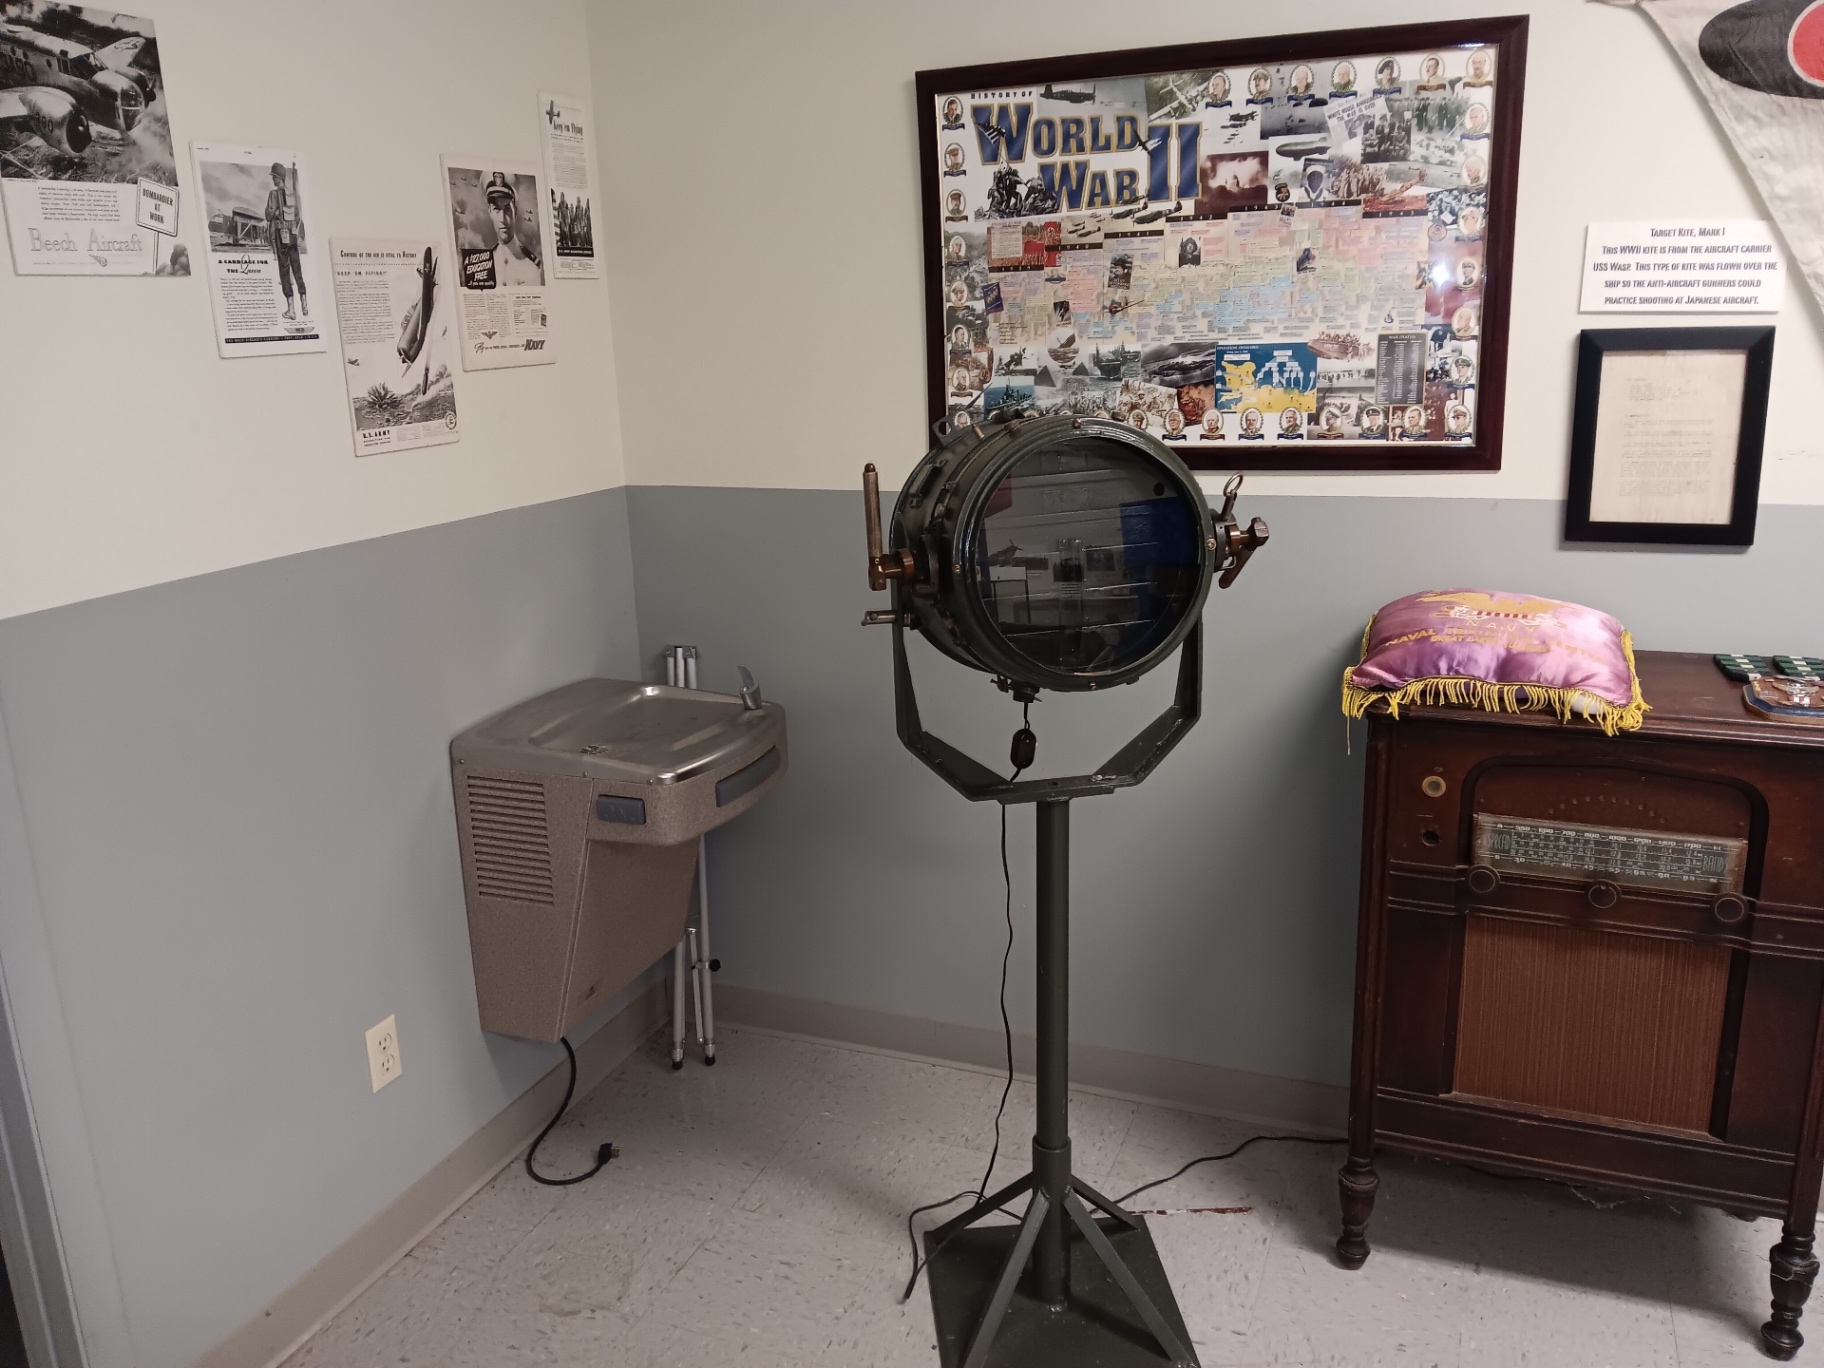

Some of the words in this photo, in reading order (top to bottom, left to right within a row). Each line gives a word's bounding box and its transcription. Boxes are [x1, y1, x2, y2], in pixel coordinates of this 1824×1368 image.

[970, 91, 1019, 100] HISTORY
[1021, 90, 1033, 98] OF
[970, 101, 1141, 166] WORLD
[1147, 121, 1203, 203] II
[1037, 159, 1141, 213] WAR
[142, 188, 174, 206] BOMBARDIER
[154, 203, 161, 212] AT
[149, 211, 164, 224] WORK
[1650, 228, 1677, 238] TARGET
[1678, 228, 1696, 238] KITE,
[1698, 227, 1721, 237] MARK
[27, 227, 78, 252] Beech
[87, 227, 143, 252] Aircraft
[1602, 245, 1618, 255] THIS
[1619, 245, 1642, 255] WWII
[1642, 246, 1658, 254] KITE
[1659, 246, 1667, 254] IS
[1667, 245, 1688, 254] FROM
[1690, 245, 1703, 254] THE
[1704, 245, 1740, 254] AIRCRAFT
[1741, 244, 1772, 253] CARRIER
[466, 260, 493, 274] EDUCATION
[1593, 262, 1608, 272] USS
[1635, 261, 1651, 271] THIS
[1652, 262, 1670, 271] TYPE
[1671, 262, 1680, 271] OF
[1681, 262, 1697, 271] KITE
[1698, 262, 1715, 271] WAS
[1716, 262, 1742, 271] FLOWN
[1743, 262, 1762, 270] OVER
[1764, 261, 1778, 270] THE
[474, 270, 488, 282] FREE
[1604, 279, 1621, 288] SHIP
[1621, 279, 1631, 288] SO
[1633, 279, 1646, 288] THE
[1646, 279, 1701, 288] ANTI-AIRCRAFT
[1702, 279, 1736, 288] GUNNERS
[1737, 279, 1762, 287] COULD
[1604, 296, 1637, 305] PRACTICE
[1638, 296, 1674, 305] SHOOTING
[1675, 296, 1684, 304] AT
[1685, 295, 1722, 305] JAPANESE
[1722, 296, 1760, 305] AIRCRAFT.
[524, 338, 546, 351] NAVY
[1465, 619, 1539, 632] NAVY
[1385, 628, 1436, 647] NAVAL
